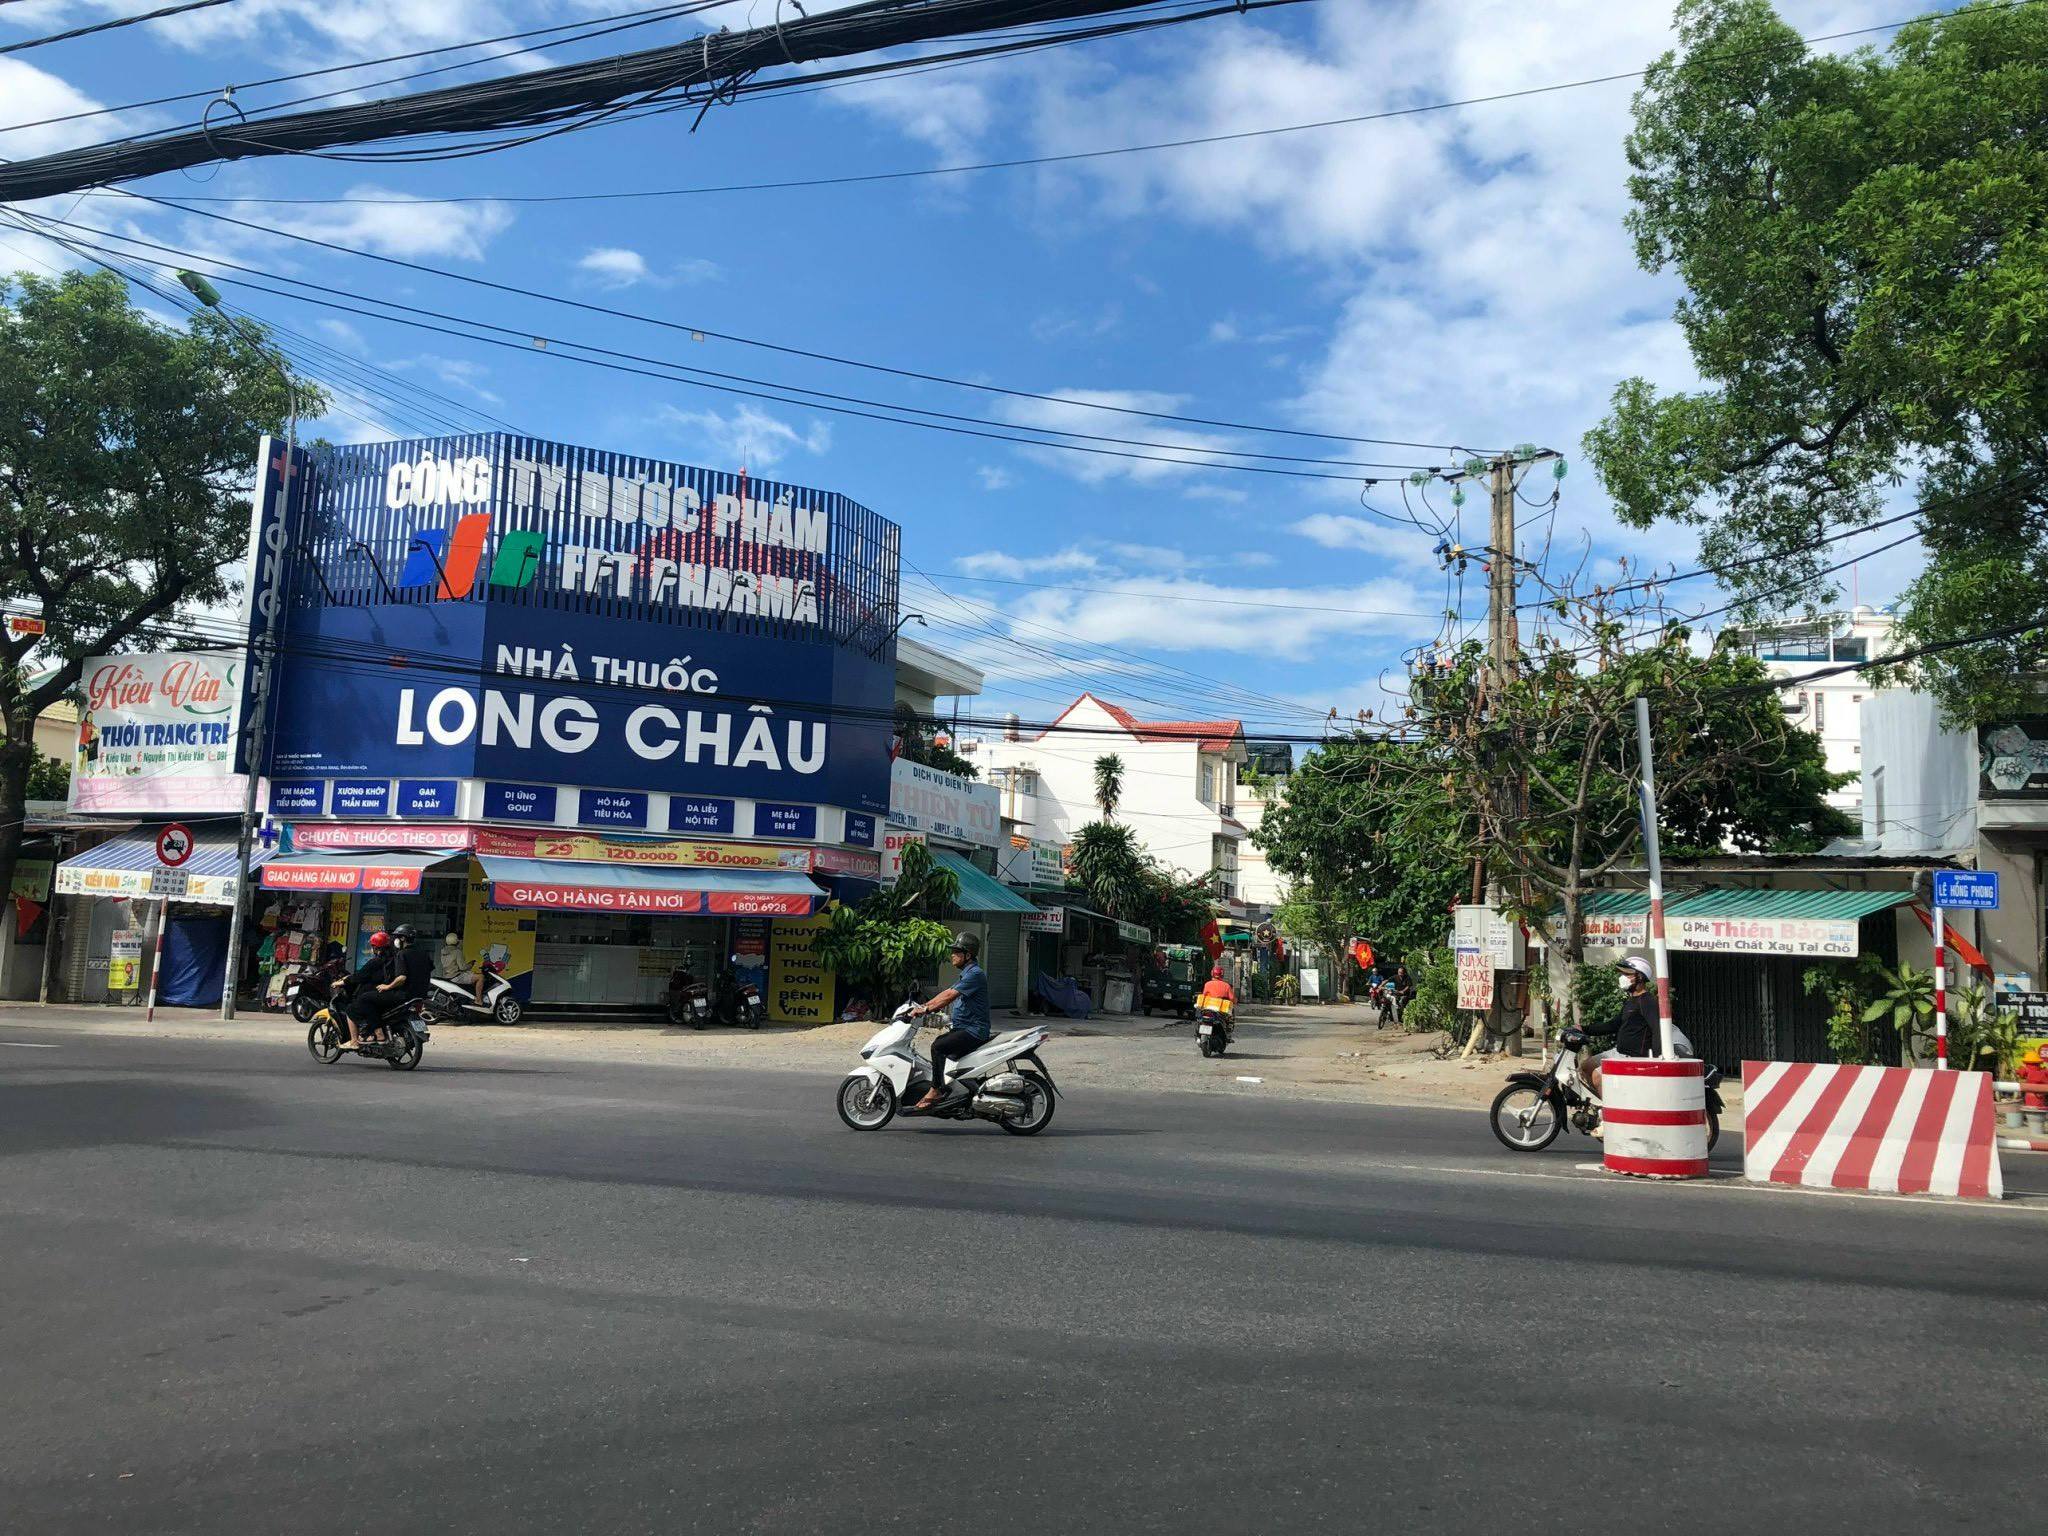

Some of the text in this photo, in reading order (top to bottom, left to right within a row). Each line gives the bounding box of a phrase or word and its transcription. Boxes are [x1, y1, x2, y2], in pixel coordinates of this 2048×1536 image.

[385, 453, 829, 555] CÔNG TY DƯỢC PHẨM
[561, 544, 819, 624] FPT PHARMA
[496, 642, 719, 695] NHÀ THUỐC
[89, 661, 221, 711] Kiều Vân
[101, 717, 140, 747] THỜI
[144, 722, 197, 746] TRANG
[396, 686, 827, 775] LONG CHÂU
[143, 751, 165, 764] Nguyễn
[913, 766, 931, 781] DỊCH
[280, 787, 315, 797] TIM MẠCH
[337, 786, 386, 796] XƯƠNG KHỚP
[418, 788, 436, 796] GAN
[505, 790, 536, 801] DỊ ỨNG
[276, 797, 317, 808] TIỂU ĐƯỜNG
[341, 798, 379, 808] THẦN KINH
[412, 799, 440, 810] DẠ DÀY
[507, 803, 533, 812] GOUT
[597, 796, 630, 807] HÔ HẤP
[686, 802, 718, 813] DA LIỄU
[593, 809, 632, 820] TIÊU HÓA
[685, 815, 719, 826] NỘI TIẾT
[771, 809, 800, 821] MẸ BẦU
[774, 821, 796, 830] EM BÉ
[298, 828, 467, 845] CHUYÊN THUỐC THEO TOA
[267, 869, 355, 884] GIAO HÀNG TẬN NƠI
[371, 877, 410, 889] 1800 6928
[1938, 880, 1994, 899] LÊ HỒNG PHONG
[512, 888, 684, 908] GIAO HÀNG TẬN NƠI
[732, 900, 787, 913] 1800 6928
[1602, 918, 1622, 934] Bảo
[1683, 921, 1693, 932] Cà
[1694, 922, 1710, 933] Phê
[1712, 921, 1774, 939] Thiên
[1780, 920, 1825, 941] Bảo
[1600, 936, 1615, 947] Xay
[1683, 938, 1730, 950] Nguyên
[1735, 938, 1763, 950] Chất
[1768, 941, 1793, 953] Xay
[1798, 941, 1818, 954] Tại
[783, 974, 820, 985] ĐƠN
[779, 989, 823, 1002] BỆNH
[781, 1005, 819, 1018] VIỆN
